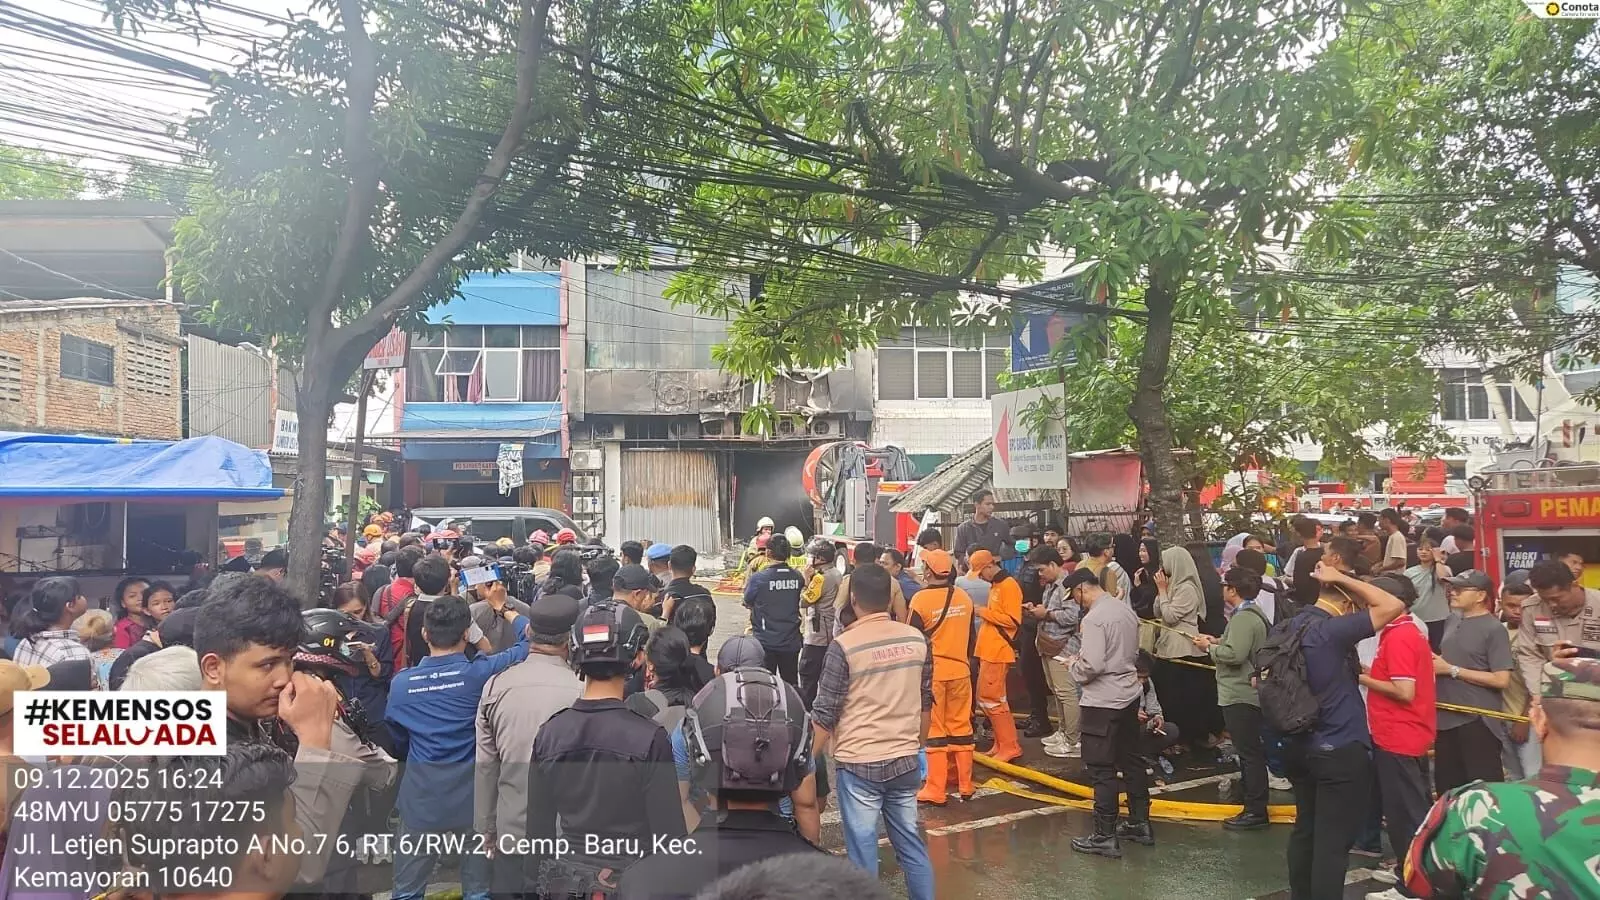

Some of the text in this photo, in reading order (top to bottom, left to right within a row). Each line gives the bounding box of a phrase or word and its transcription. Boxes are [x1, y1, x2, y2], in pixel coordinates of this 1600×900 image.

[1541, 496, 1600, 518] PEMA
[1505, 552, 1537, 560] TANGKI
[1509, 560, 1535, 568] FOAM
[769, 579, 799, 591] POLISI
[323, 637, 335, 648] 01
